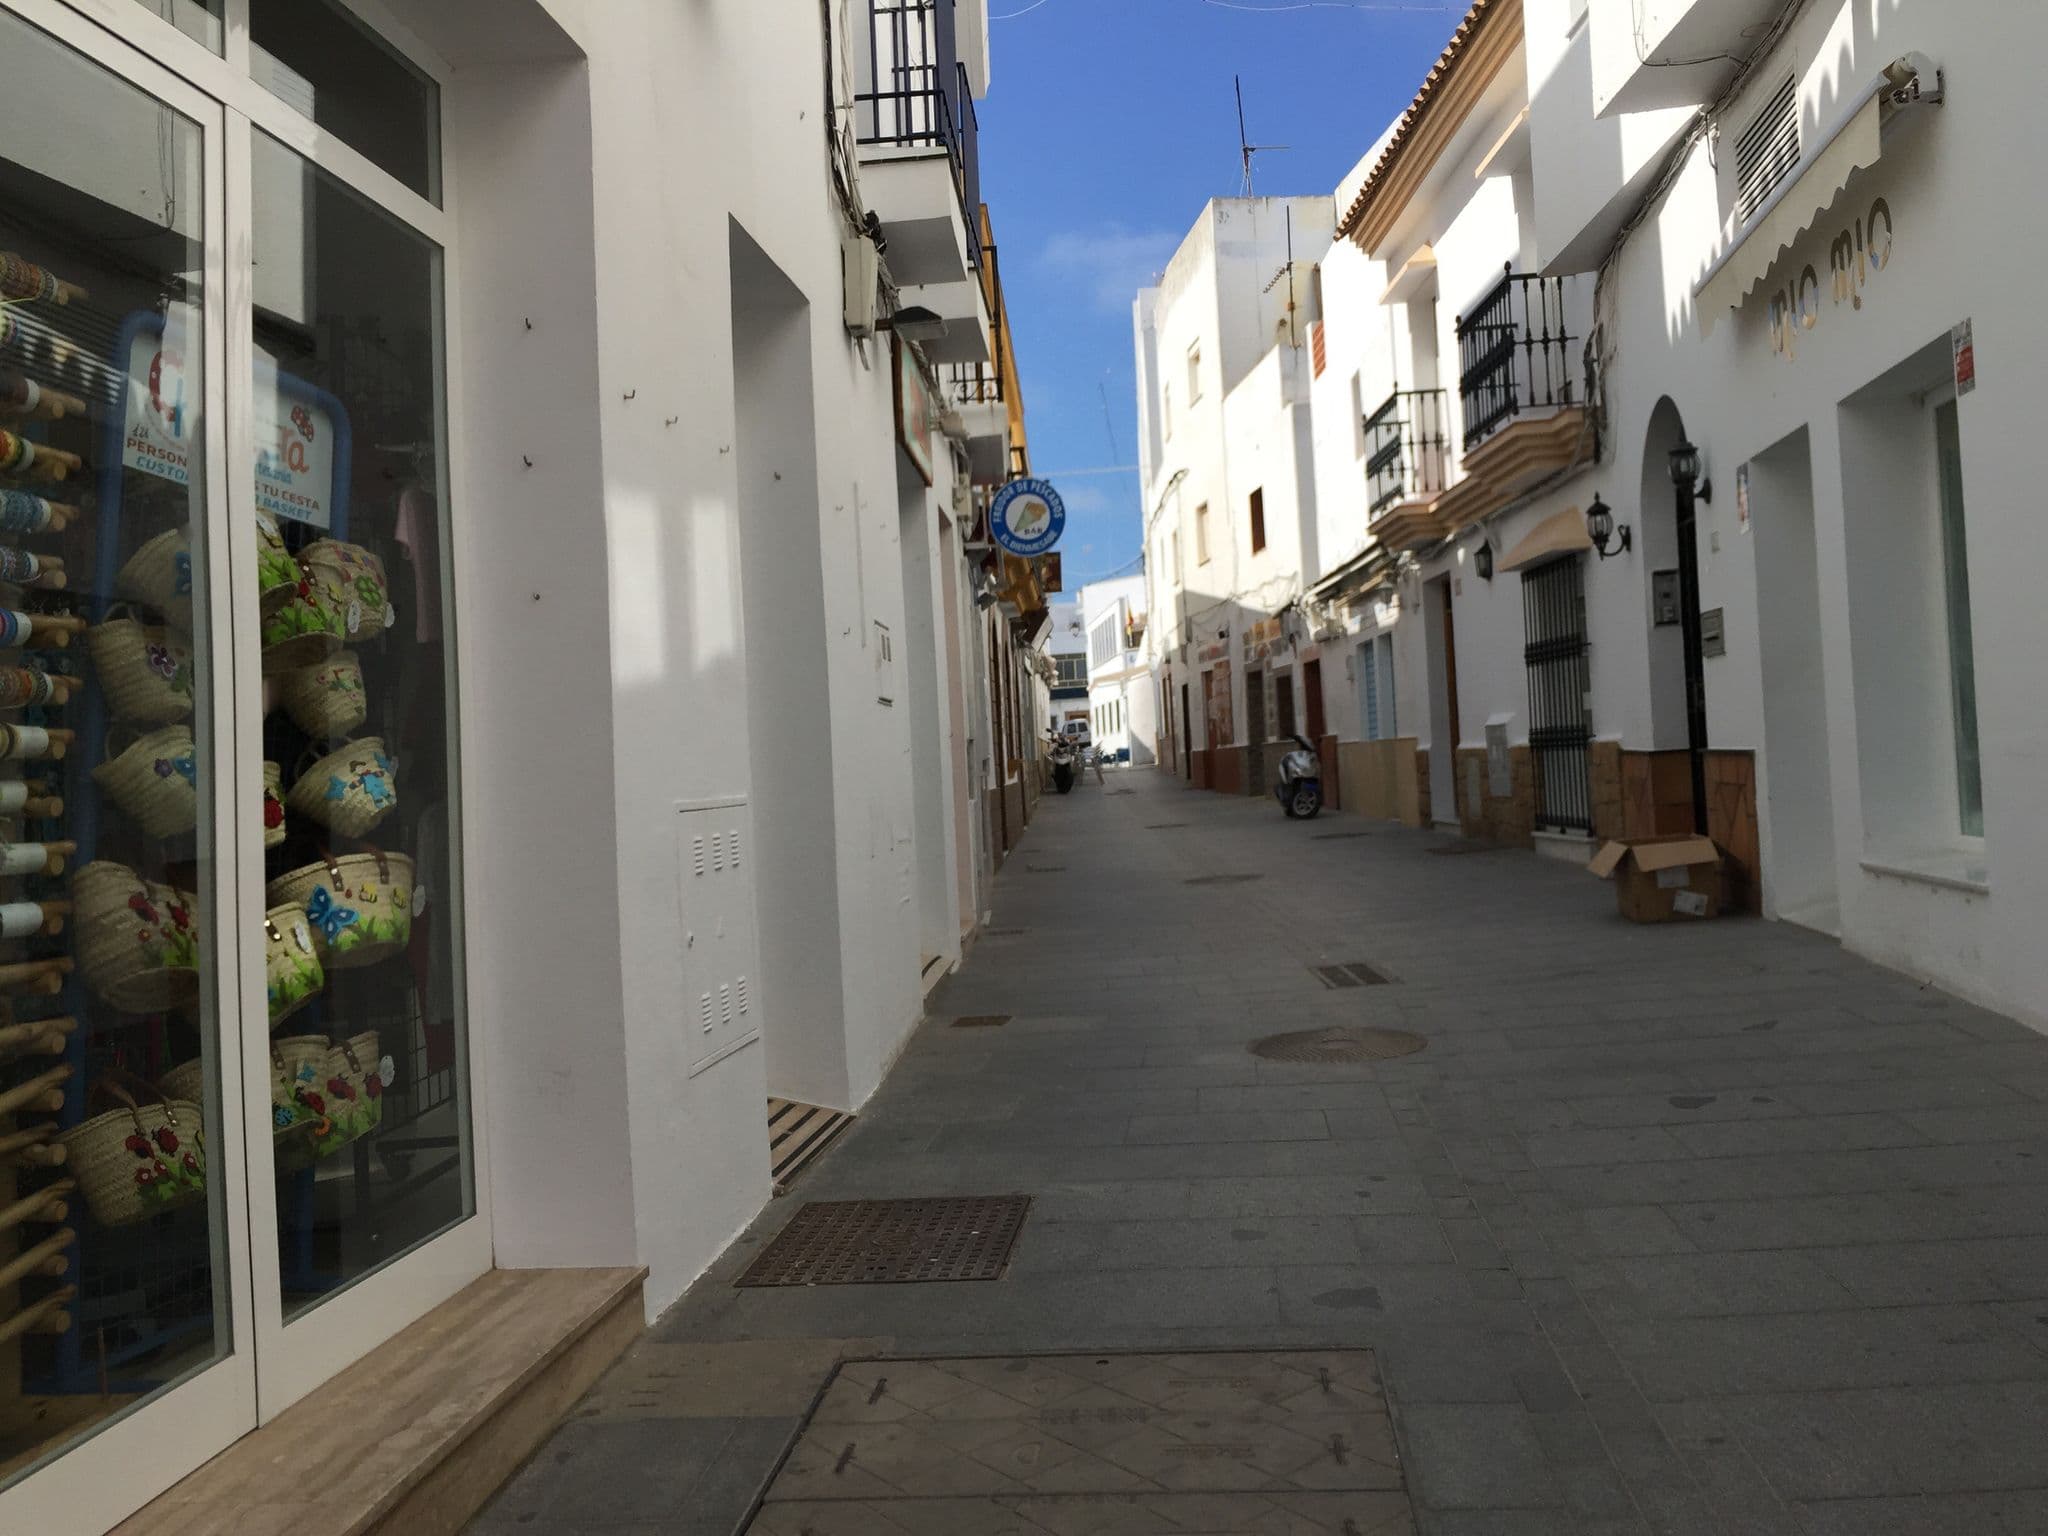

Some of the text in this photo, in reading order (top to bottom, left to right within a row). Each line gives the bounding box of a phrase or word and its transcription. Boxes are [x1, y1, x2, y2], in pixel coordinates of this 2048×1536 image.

[264, 498, 312, 520] BASKET
[282, 490, 320, 510] CESTA
[1031, 480, 1063, 520] PESCADOS
